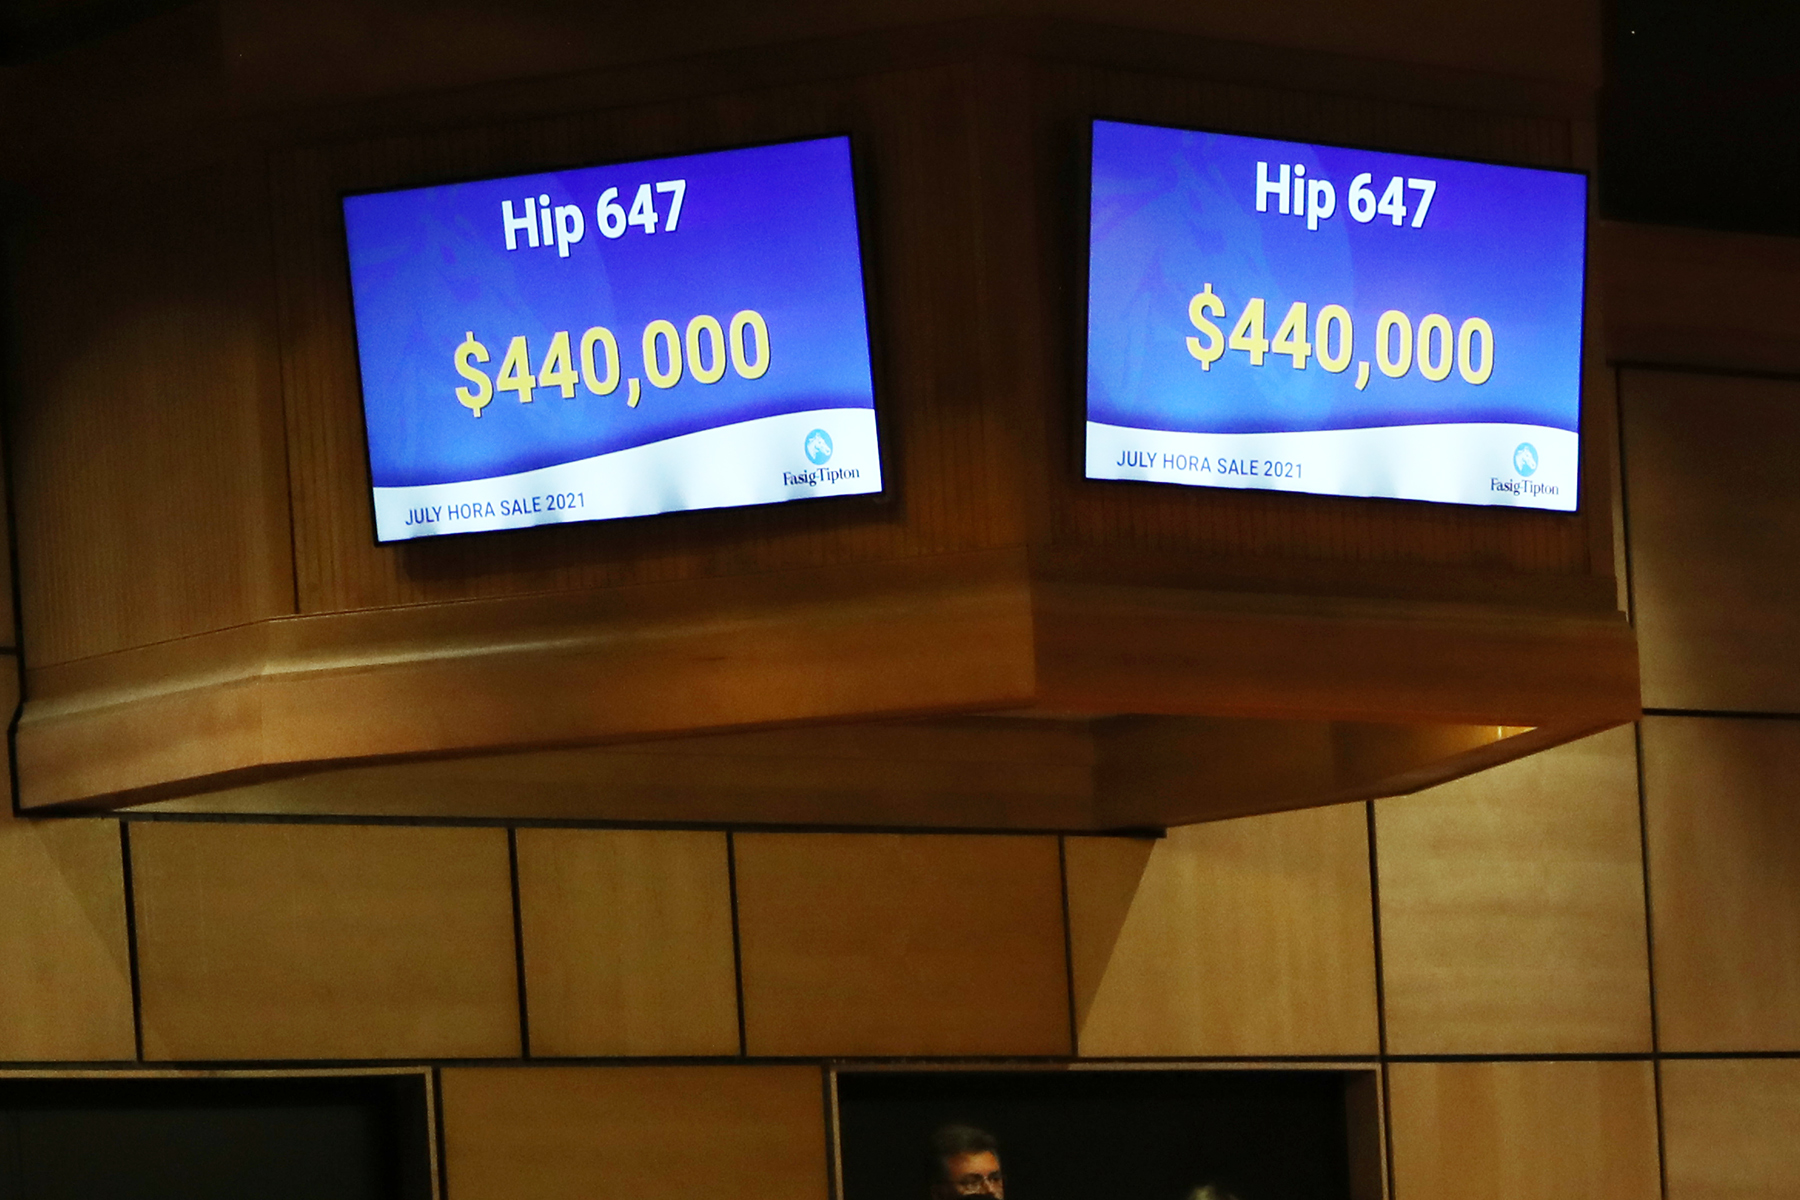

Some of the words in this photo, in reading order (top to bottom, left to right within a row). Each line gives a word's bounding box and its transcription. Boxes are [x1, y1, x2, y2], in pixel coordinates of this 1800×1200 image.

[502, 194, 584, 258] Hip
[597, 180, 686, 238] 647
[1256, 162, 1336, 231] Hip
[1349, 173, 1436, 228] 647
[1186, 283, 1494, 391] $440,000
[454, 310, 770, 418] $440,000
[783, 466, 860, 485] Fasig-Tipton
[1117, 450, 1156, 469] JULY
[1163, 453, 1211, 472] HORA
[1217, 458, 1258, 475] SALE
[1264, 461, 1303, 479] 2021
[1490, 477, 1559, 496] Fasig-Tipton
[405, 507, 442, 526] JULY
[448, 502, 496, 521] HORA
[501, 497, 541, 517] SALE
[547, 492, 585, 512] 2021
